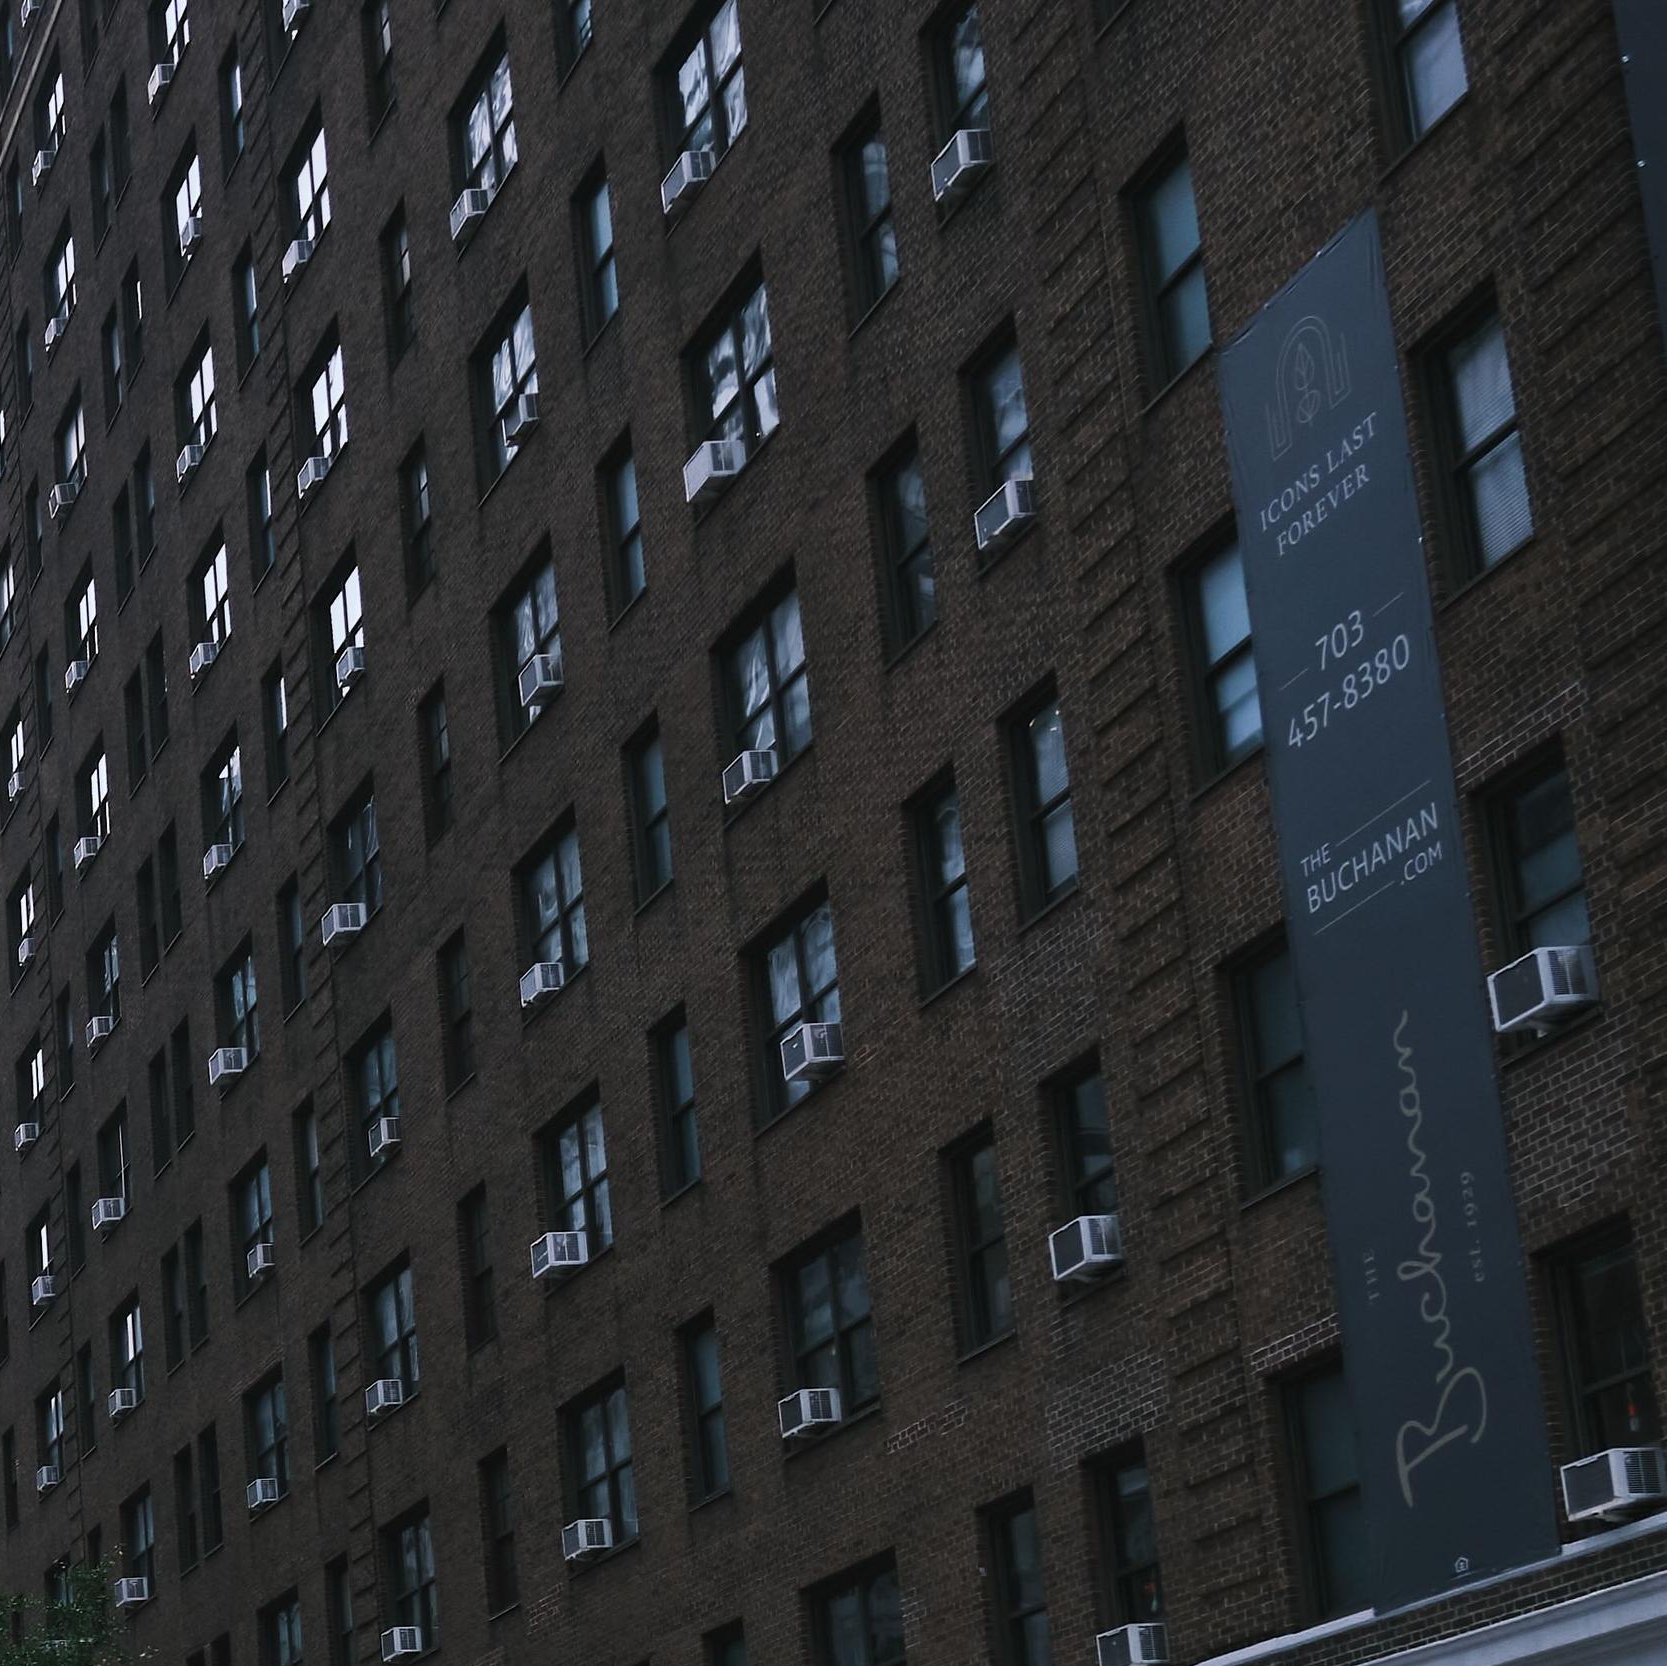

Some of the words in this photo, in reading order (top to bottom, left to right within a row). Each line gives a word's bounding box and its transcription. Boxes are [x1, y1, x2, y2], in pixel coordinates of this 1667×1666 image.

[1259, 463, 1321, 532] ICONS
[1325, 411, 1377, 474] LAST
[1275, 463, 1371, 557] FOREVER
[1287, 633, 1410, 748] 457-8380
[1315, 609, 1365, 671] 703
[1299, 842, 1332, 877] THE
[1306, 801, 1440, 914] BUCHANAN
[1392, 1009, 1488, 1508] Buchanan
